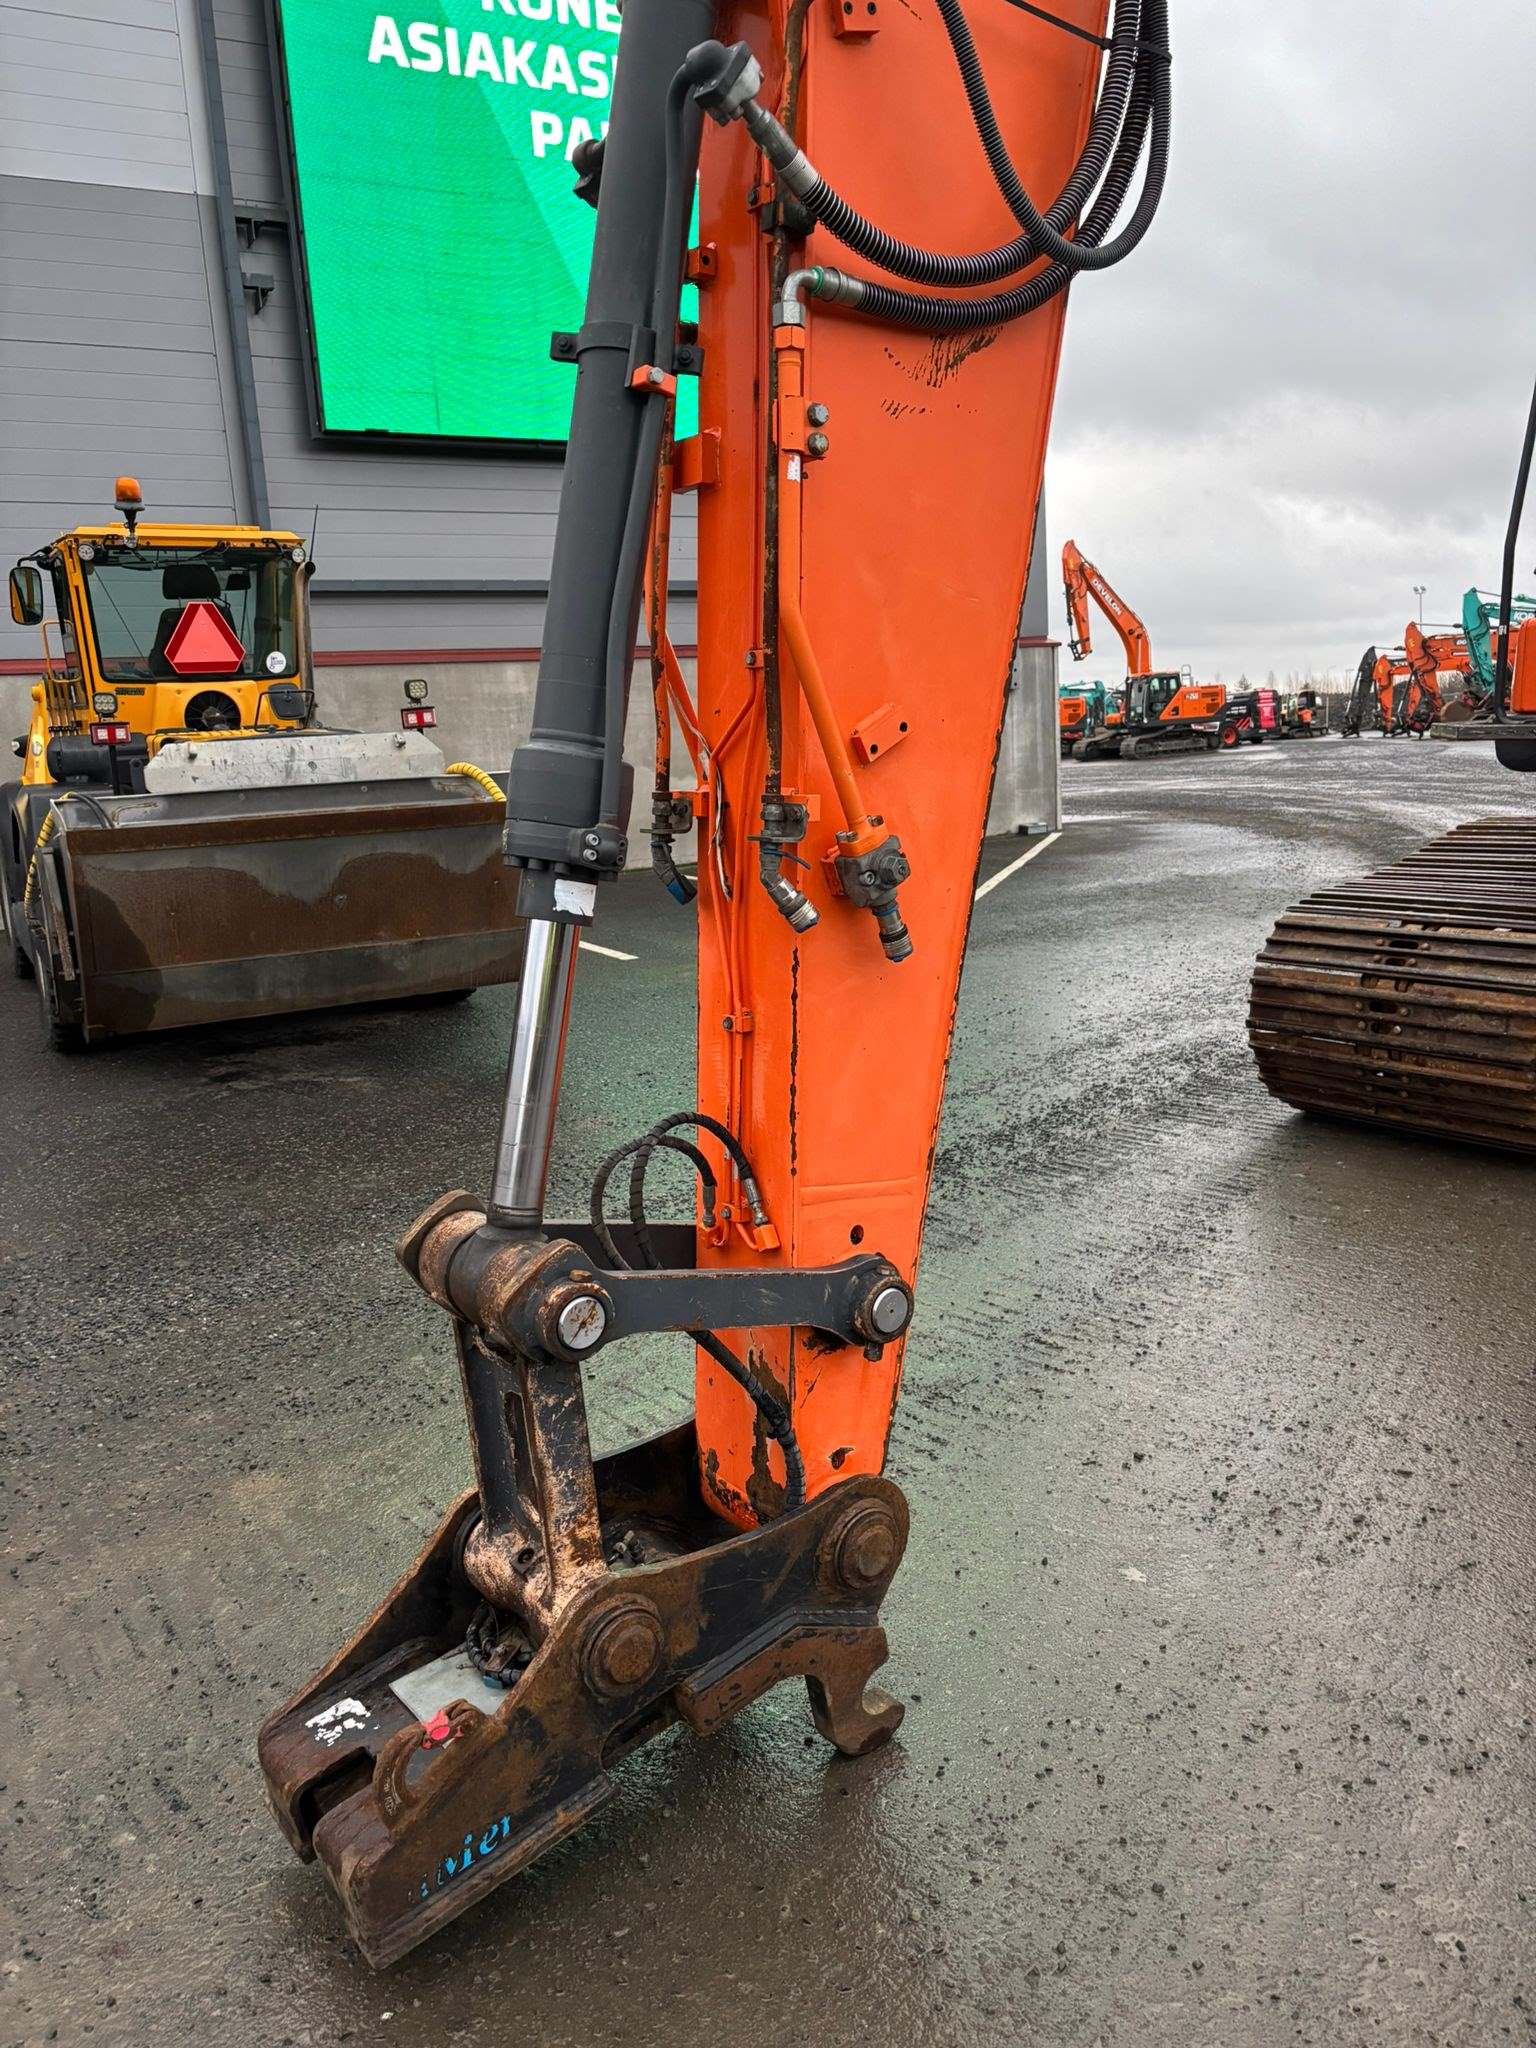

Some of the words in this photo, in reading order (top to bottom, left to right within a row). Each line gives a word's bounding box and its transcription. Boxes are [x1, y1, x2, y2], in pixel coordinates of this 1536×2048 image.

[367, 15, 617, 99] ASIAKAS
[530, 110, 609, 162] PA
[1091, 578, 1121, 615] DEVELON
